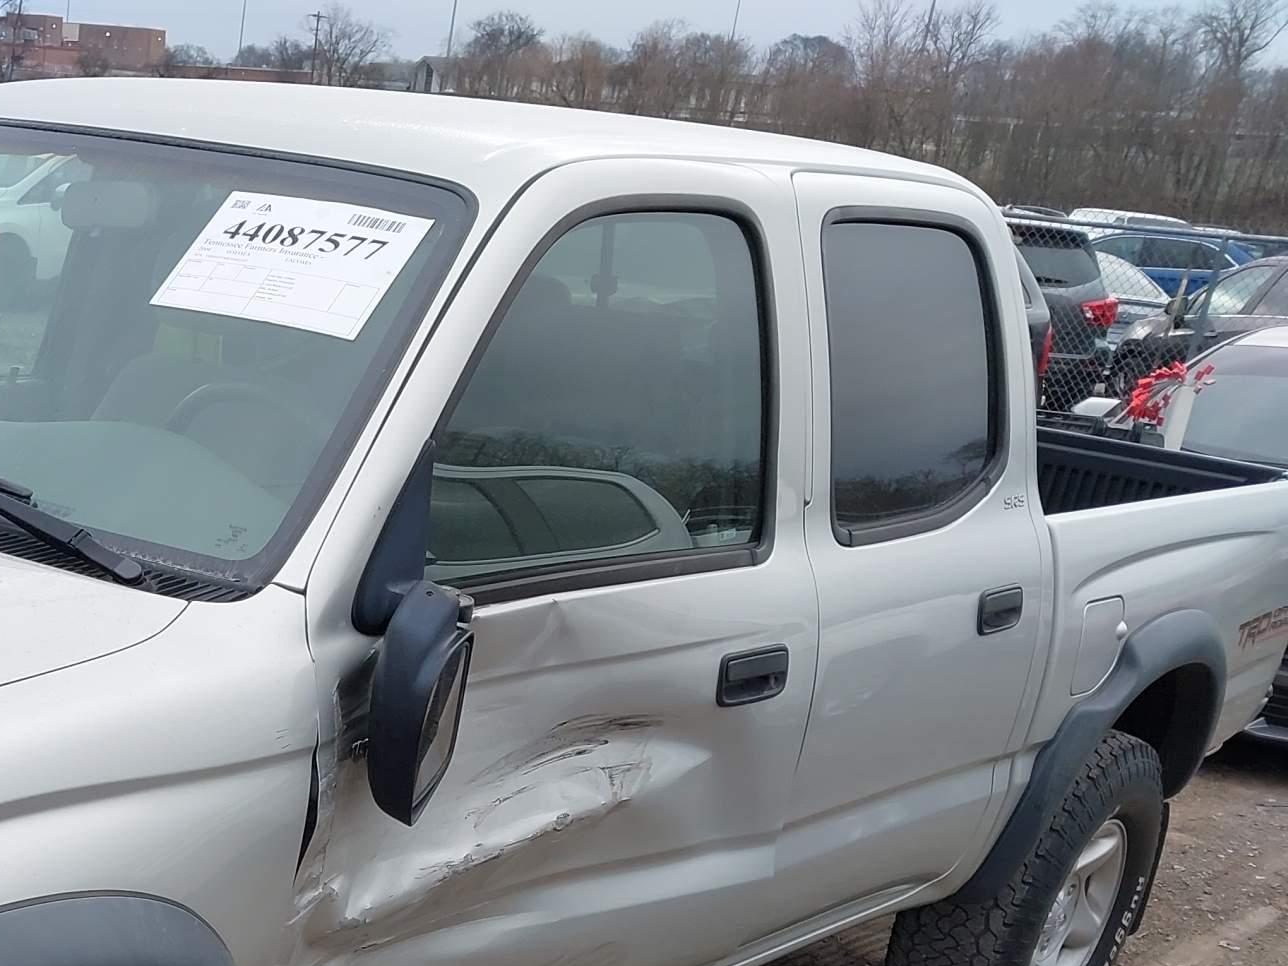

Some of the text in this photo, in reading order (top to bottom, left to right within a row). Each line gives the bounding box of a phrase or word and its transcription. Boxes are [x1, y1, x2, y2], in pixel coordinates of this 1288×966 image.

[203, 239, 243, 249] Tennessee
[244, 244, 277, 253] Farmers
[279, 248, 319, 259] Insurance
[223, 220, 389, 260] 44087577
